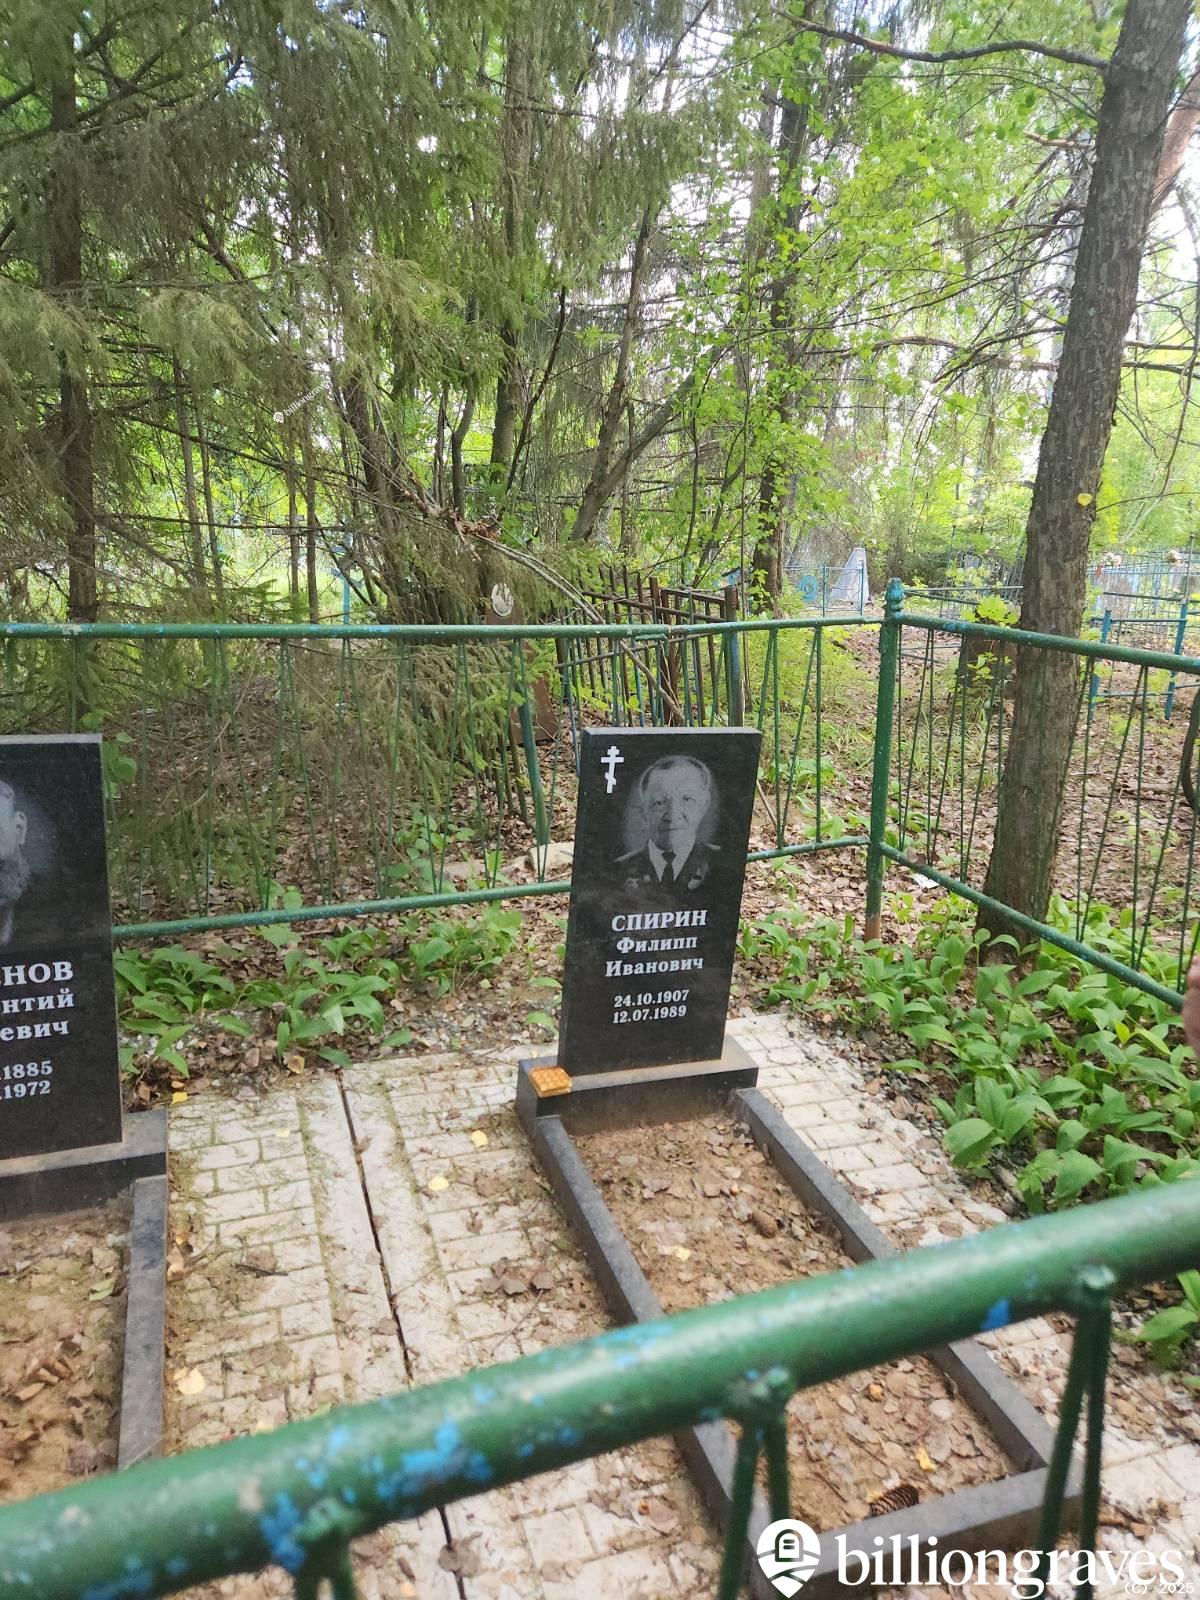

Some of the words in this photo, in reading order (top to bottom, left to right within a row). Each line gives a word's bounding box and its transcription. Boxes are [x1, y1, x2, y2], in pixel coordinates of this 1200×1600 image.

[611, 909, 708, 932] СПИРИН
[616, 936, 697, 954] Филипп
[0, 961, 74, 986] НОВ
[604, 957, 704, 977] Иванович
[613, 989, 690, 1008] 24.10.1907
[612, 1005, 687, 1024] 12.07.1989
